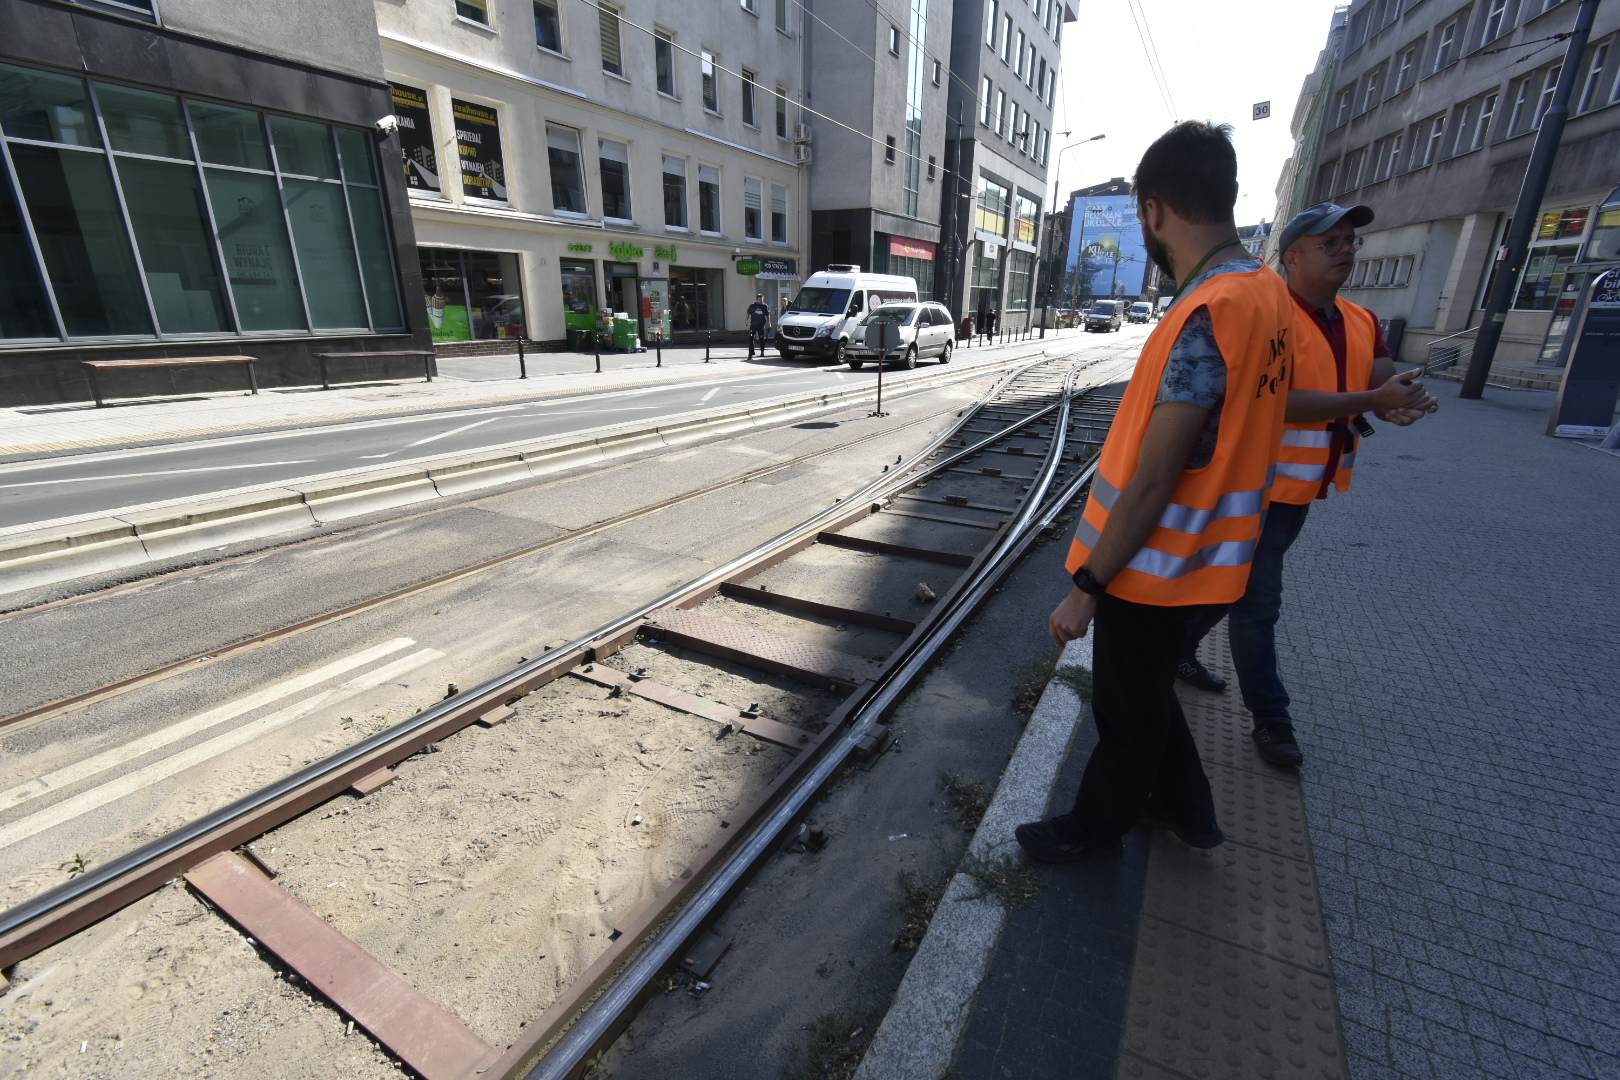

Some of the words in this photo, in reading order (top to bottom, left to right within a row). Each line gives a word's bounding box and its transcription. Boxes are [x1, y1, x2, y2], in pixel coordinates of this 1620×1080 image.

[1255, 105, 1268, 116] 30
[1084, 210, 1122, 220] POZNAŃ
[235, 244, 265, 257] BIURA
[609, 241, 644, 258] żabka
